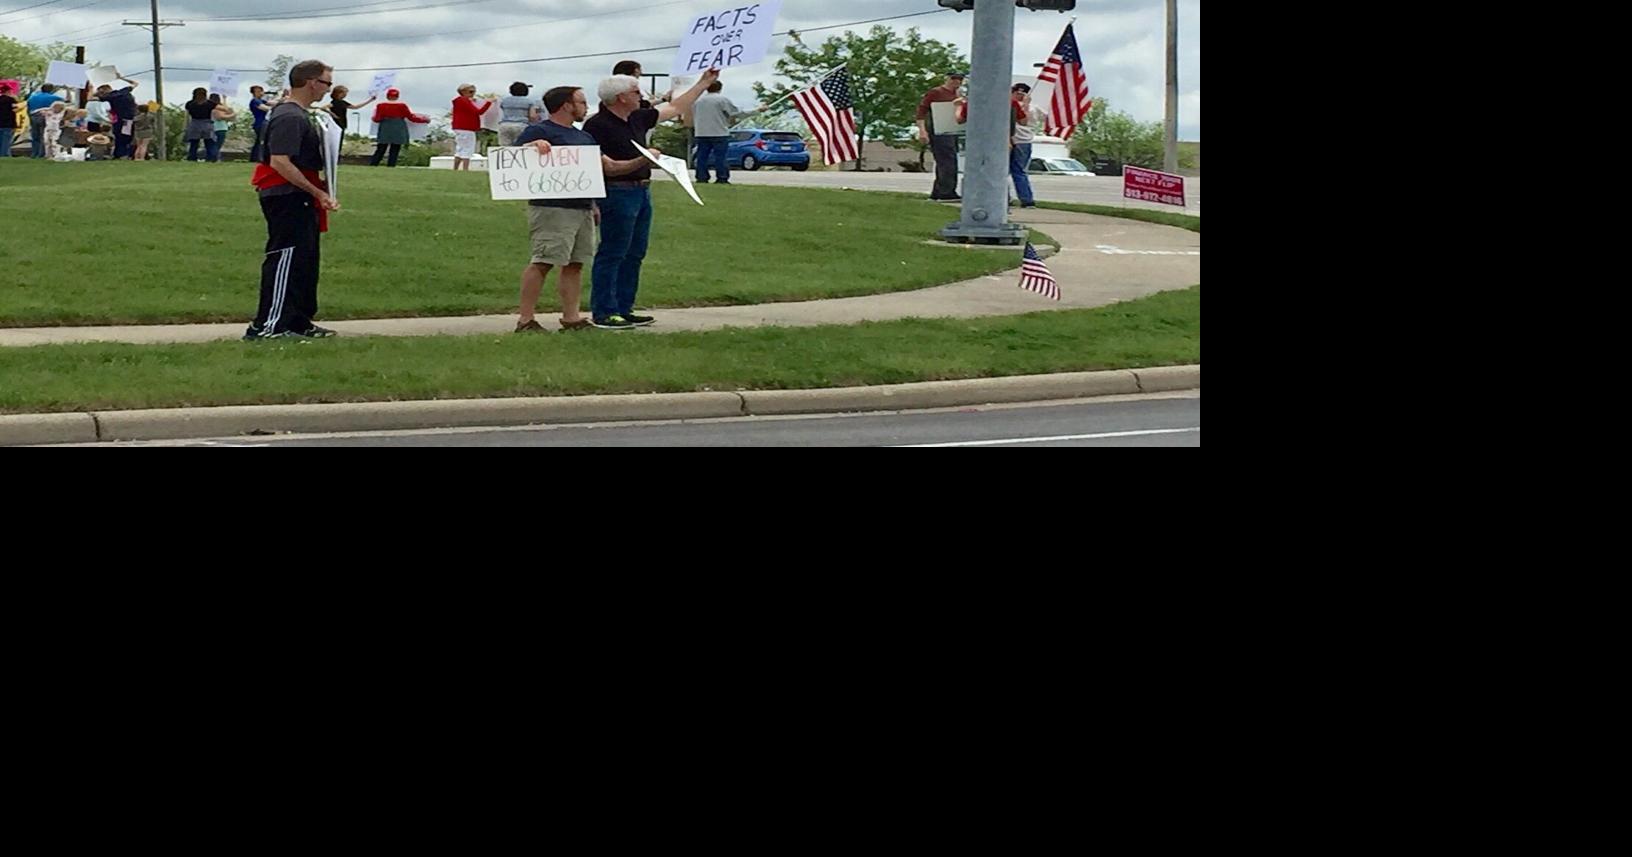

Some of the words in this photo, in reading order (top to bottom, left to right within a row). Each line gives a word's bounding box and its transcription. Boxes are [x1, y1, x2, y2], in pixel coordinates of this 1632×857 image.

[691, 4, 759, 34] FACTS
[711, 29, 743, 46] OVER
[686, 44, 743, 71] FEAR
[490, 147, 528, 170] TEXT
[499, 173, 520, 192] to
[528, 170, 592, 194] 66866
